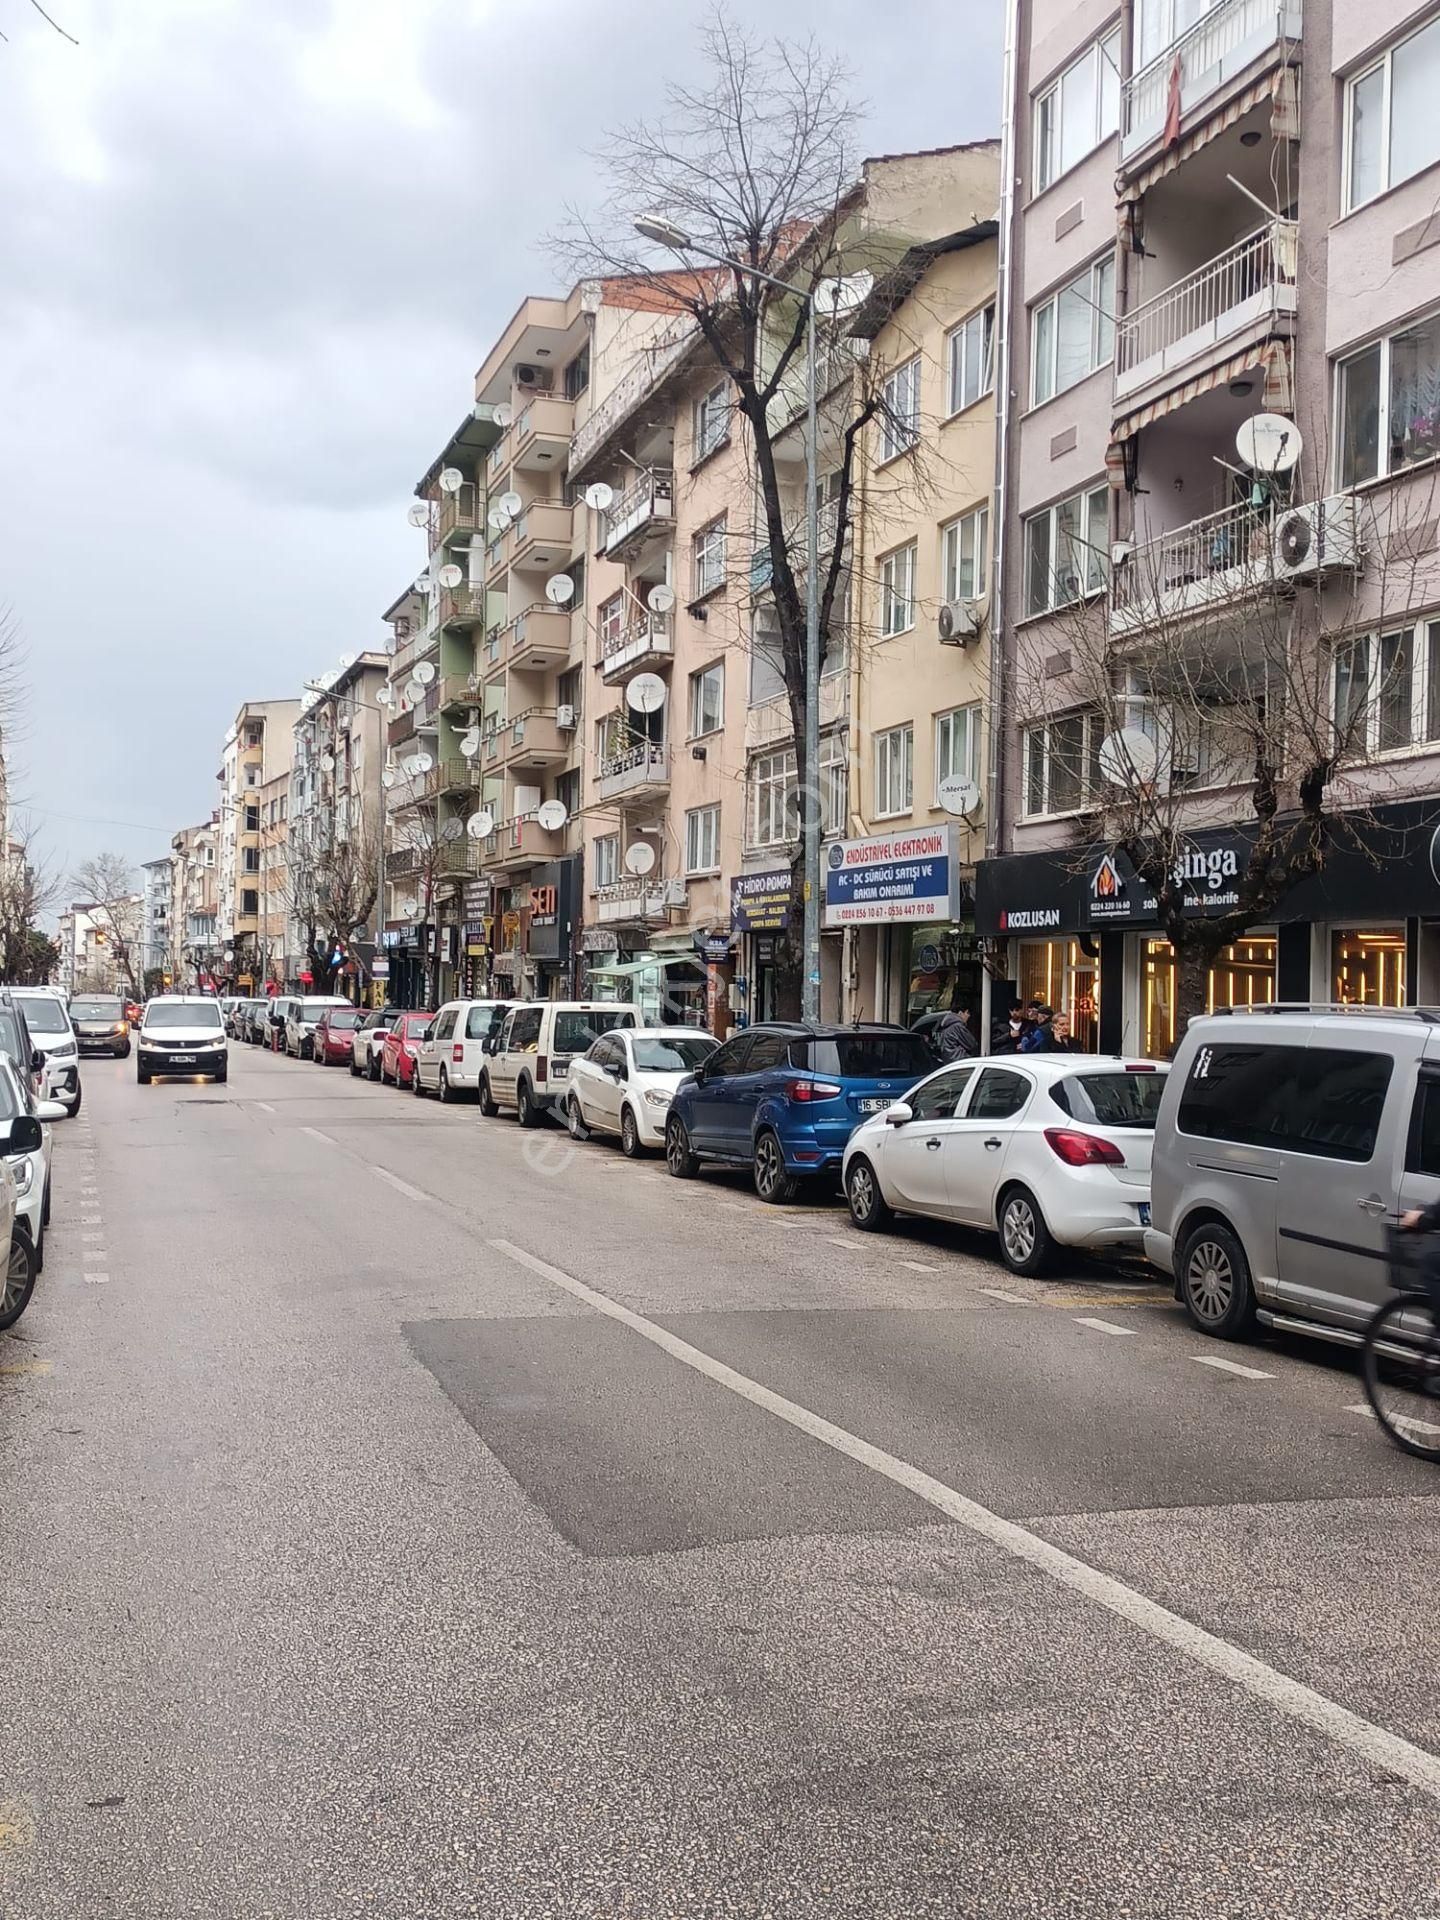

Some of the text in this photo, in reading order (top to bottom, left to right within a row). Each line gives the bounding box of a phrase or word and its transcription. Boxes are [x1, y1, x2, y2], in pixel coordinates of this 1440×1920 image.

[846, 841, 892, 864] ENDÜSTRİYEL
[894, 831, 942, 857] ELEKTRONİK
[744, 876, 765, 894] HİDRO
[766, 874, 791, 891] POMPA
[838, 875, 848, 887] AC
[853, 873, 863, 884] DC
[864, 866, 894, 883] SÜRÜCÜ
[895, 867, 920, 884] SATIŞI
[921, 864, 932, 876] VE
[853, 883, 914, 900] BAKIM ONARIMI
[842, 907, 855, 919] 0224
[868, 907, 875, 917] 10
[876, 907, 883, 917] 67
[888, 905, 903, 917] 0536
[904, 905, 915, 916] 447
[917, 904, 925, 914] 97
[926, 903, 934, 914] 08
[1007, 909, 1060, 929] KOZLUSAN
[863, 1100, 871, 1110] 16
